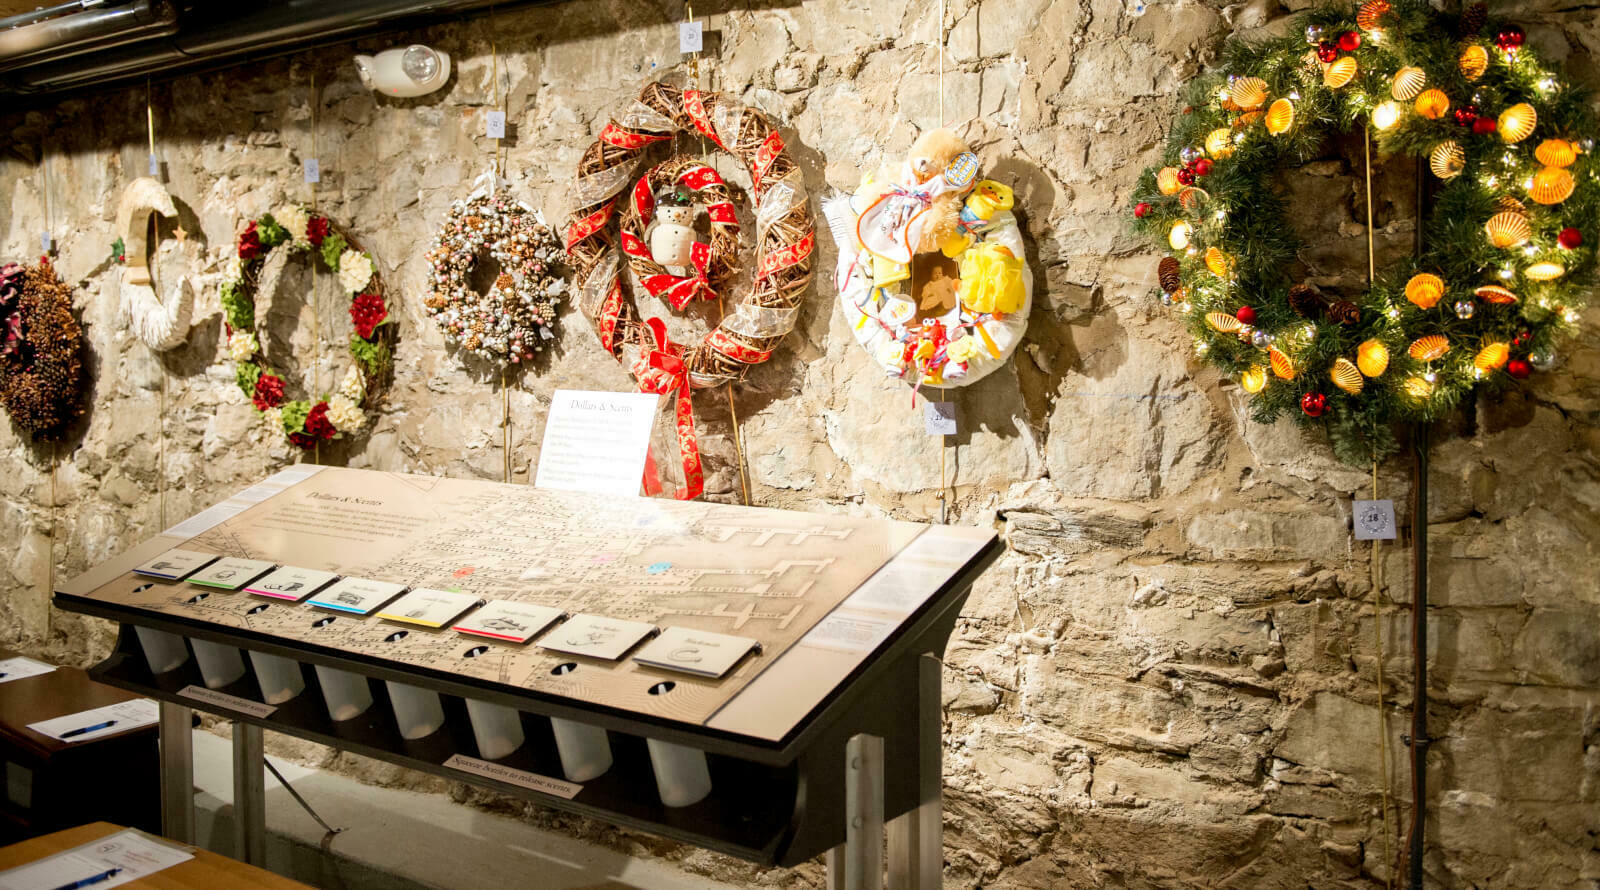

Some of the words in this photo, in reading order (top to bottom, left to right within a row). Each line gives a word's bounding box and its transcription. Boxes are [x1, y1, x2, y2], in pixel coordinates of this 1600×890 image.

[570, 399, 597, 411] Dollars
[453, 757, 482, 768] Squeeze
[483, 765, 509, 776] bottles
[518, 775, 545, 786] release
